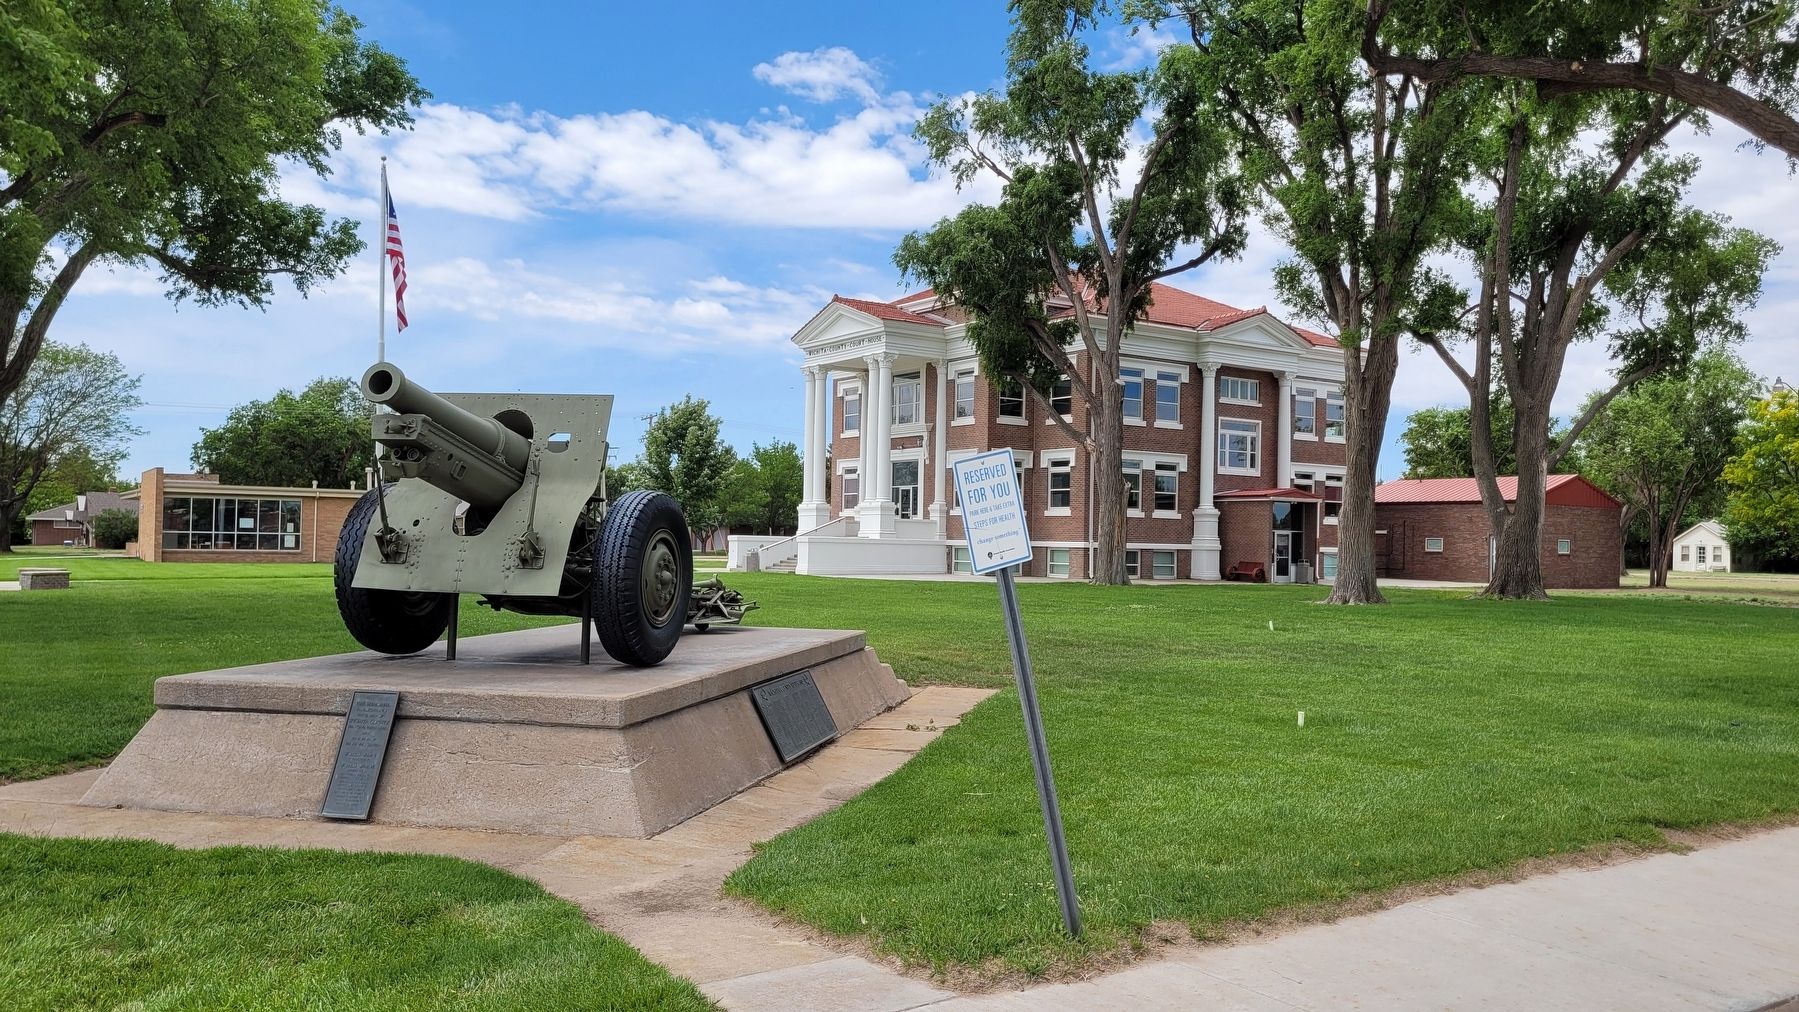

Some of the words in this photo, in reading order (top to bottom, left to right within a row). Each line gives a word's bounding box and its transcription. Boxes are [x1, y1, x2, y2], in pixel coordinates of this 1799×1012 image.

[829, 343, 847, 352] COUNTY
[849, 340, 865, 349] COURT
[867, 335, 882, 344] HOUSE
[964, 463, 1007, 484] RESERVED
[968, 487, 987, 504] FOR
[990, 482, 1010, 499] YOU
[969, 509, 979, 517] PARK
[980, 507, 990, 515] HERE
[1002, 500, 1016, 509] EXTRA
[973, 520, 989, 529] STEPS
[988, 517, 998, 525] FOR
[998, 512, 1016, 523] HEALTH
[977, 536, 994, 546] change
